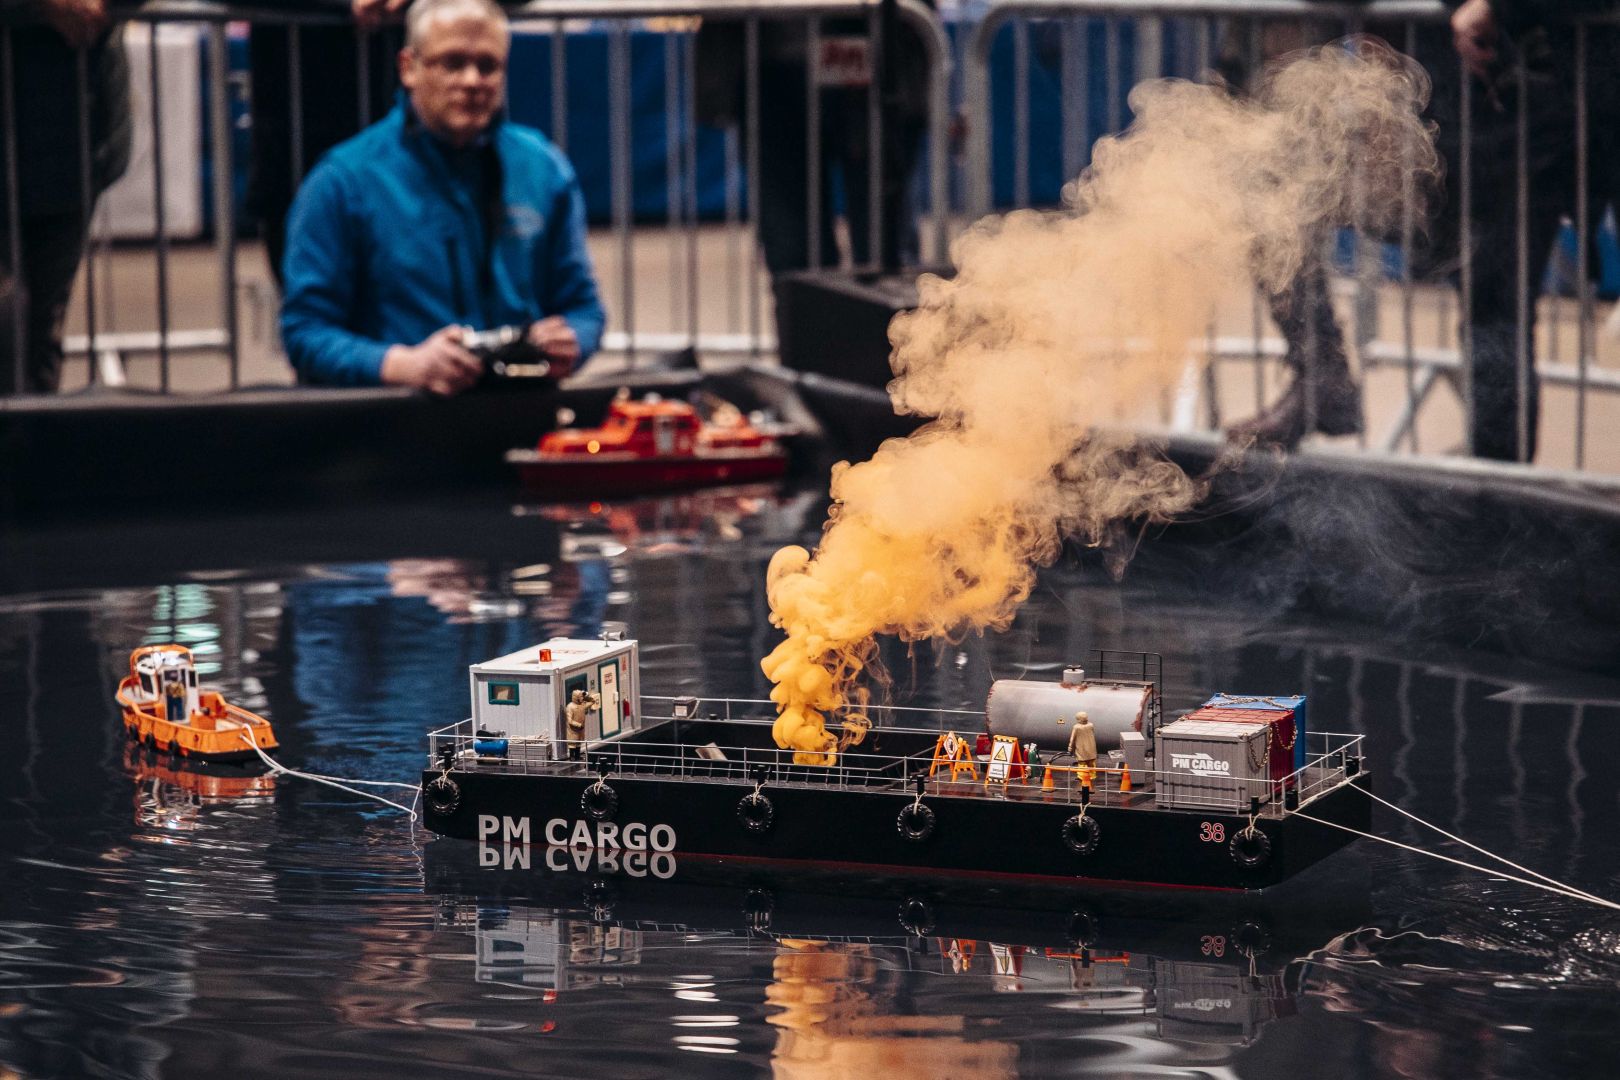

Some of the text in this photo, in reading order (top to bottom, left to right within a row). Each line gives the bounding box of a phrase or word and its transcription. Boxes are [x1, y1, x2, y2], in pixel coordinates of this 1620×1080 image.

[1172, 757, 1230, 771] PM CARGO
[478, 814, 677, 852] PM CARGO
[1200, 821, 1225, 843] 38
